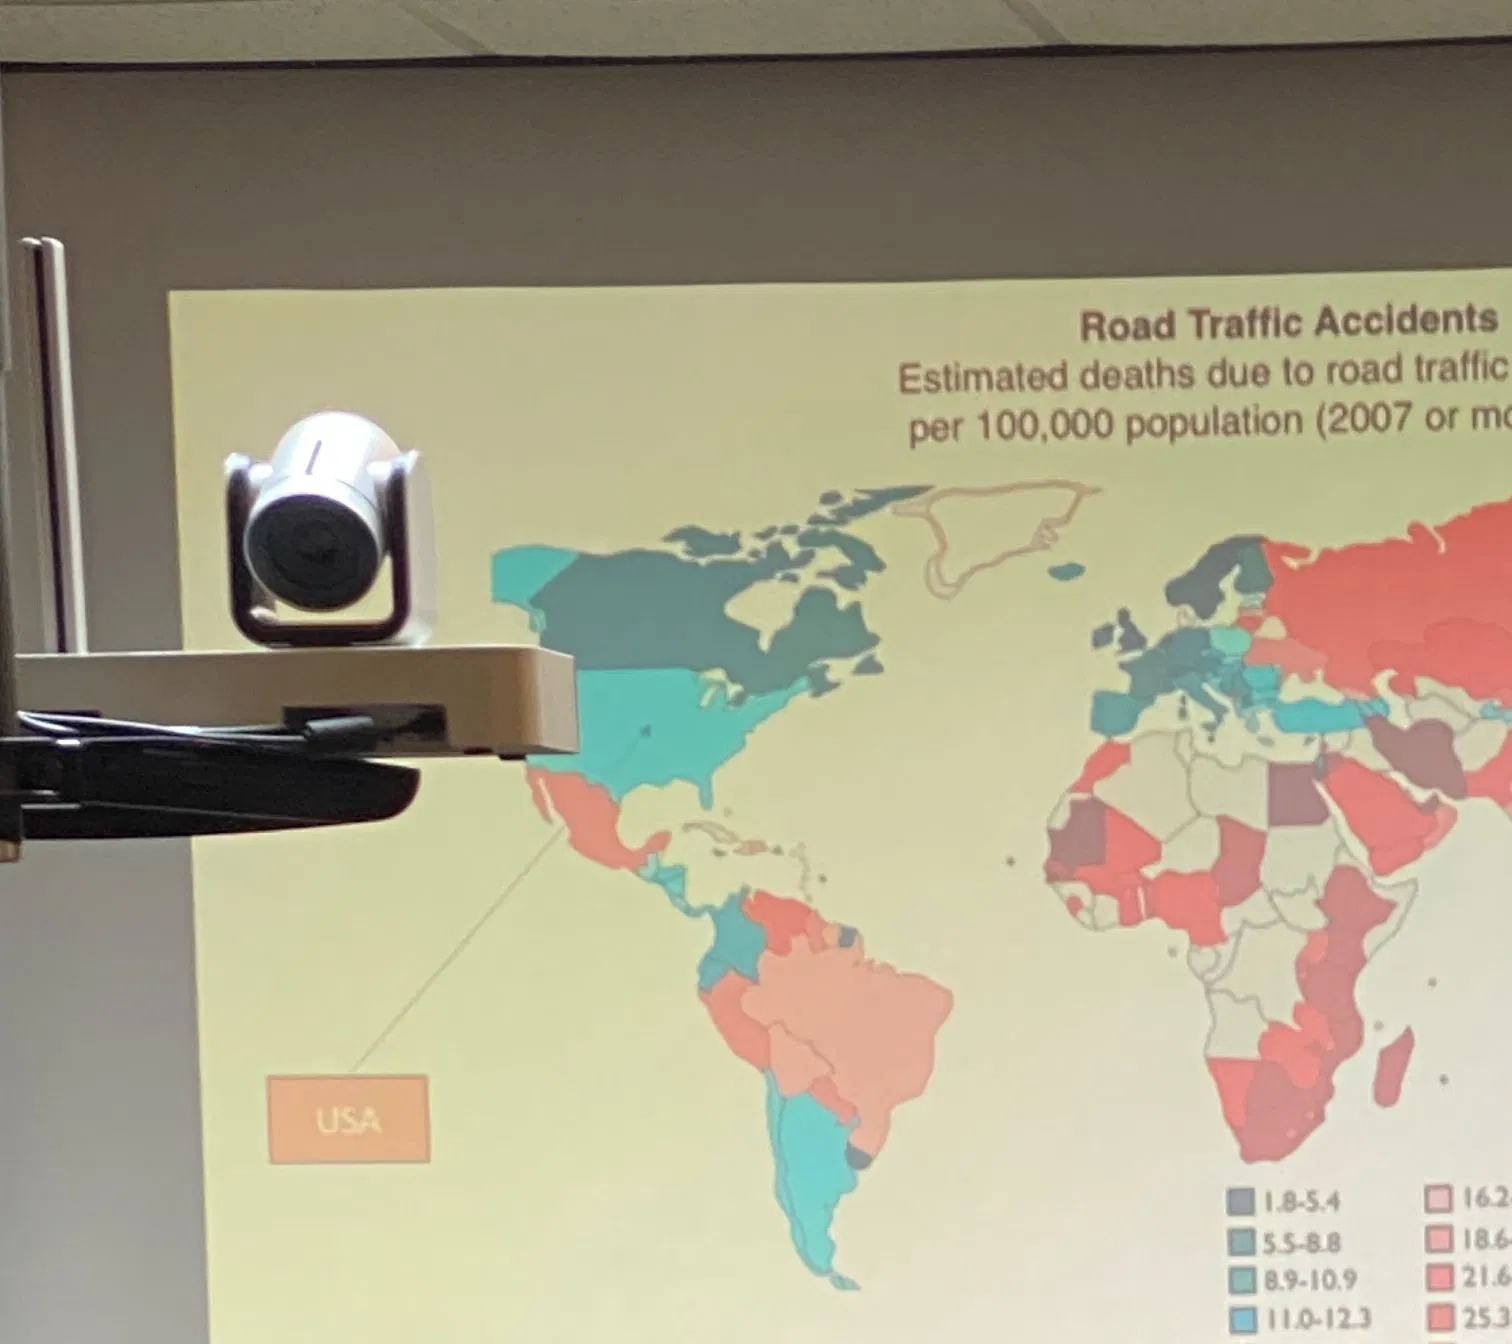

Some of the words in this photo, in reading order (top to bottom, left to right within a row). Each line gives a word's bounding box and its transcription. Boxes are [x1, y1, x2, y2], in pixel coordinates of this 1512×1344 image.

[1080, 309, 1176, 342] Road
[1188, 304, 1303, 341] Traffic
[1314, 302, 1499, 337] Accidents
[898, 359, 1069, 395] Estimated
[1079, 357, 1196, 392] deaths
[1206, 357, 1272, 388] due
[1282, 357, 1315, 387] to
[1326, 349, 1404, 386] road
[1414, 349, 1510, 384] traffic
[908, 416, 964, 450] per
[976, 407, 1115, 445] 100,000
[1125, 400, 1304, 445] population
[1316, 399, 1414, 440] (2007
[1424, 403, 1460, 432] or
[316, 1106, 384, 1135] USA
[1263, 1191, 1341, 1213] 1.8-5.4
[1262, 1232, 1342, 1254] 5.5-8.8
[1263, 1269, 1358, 1292] 8.9-10.9
[1267, 1307, 1373, 1330] 11.0-12.3
